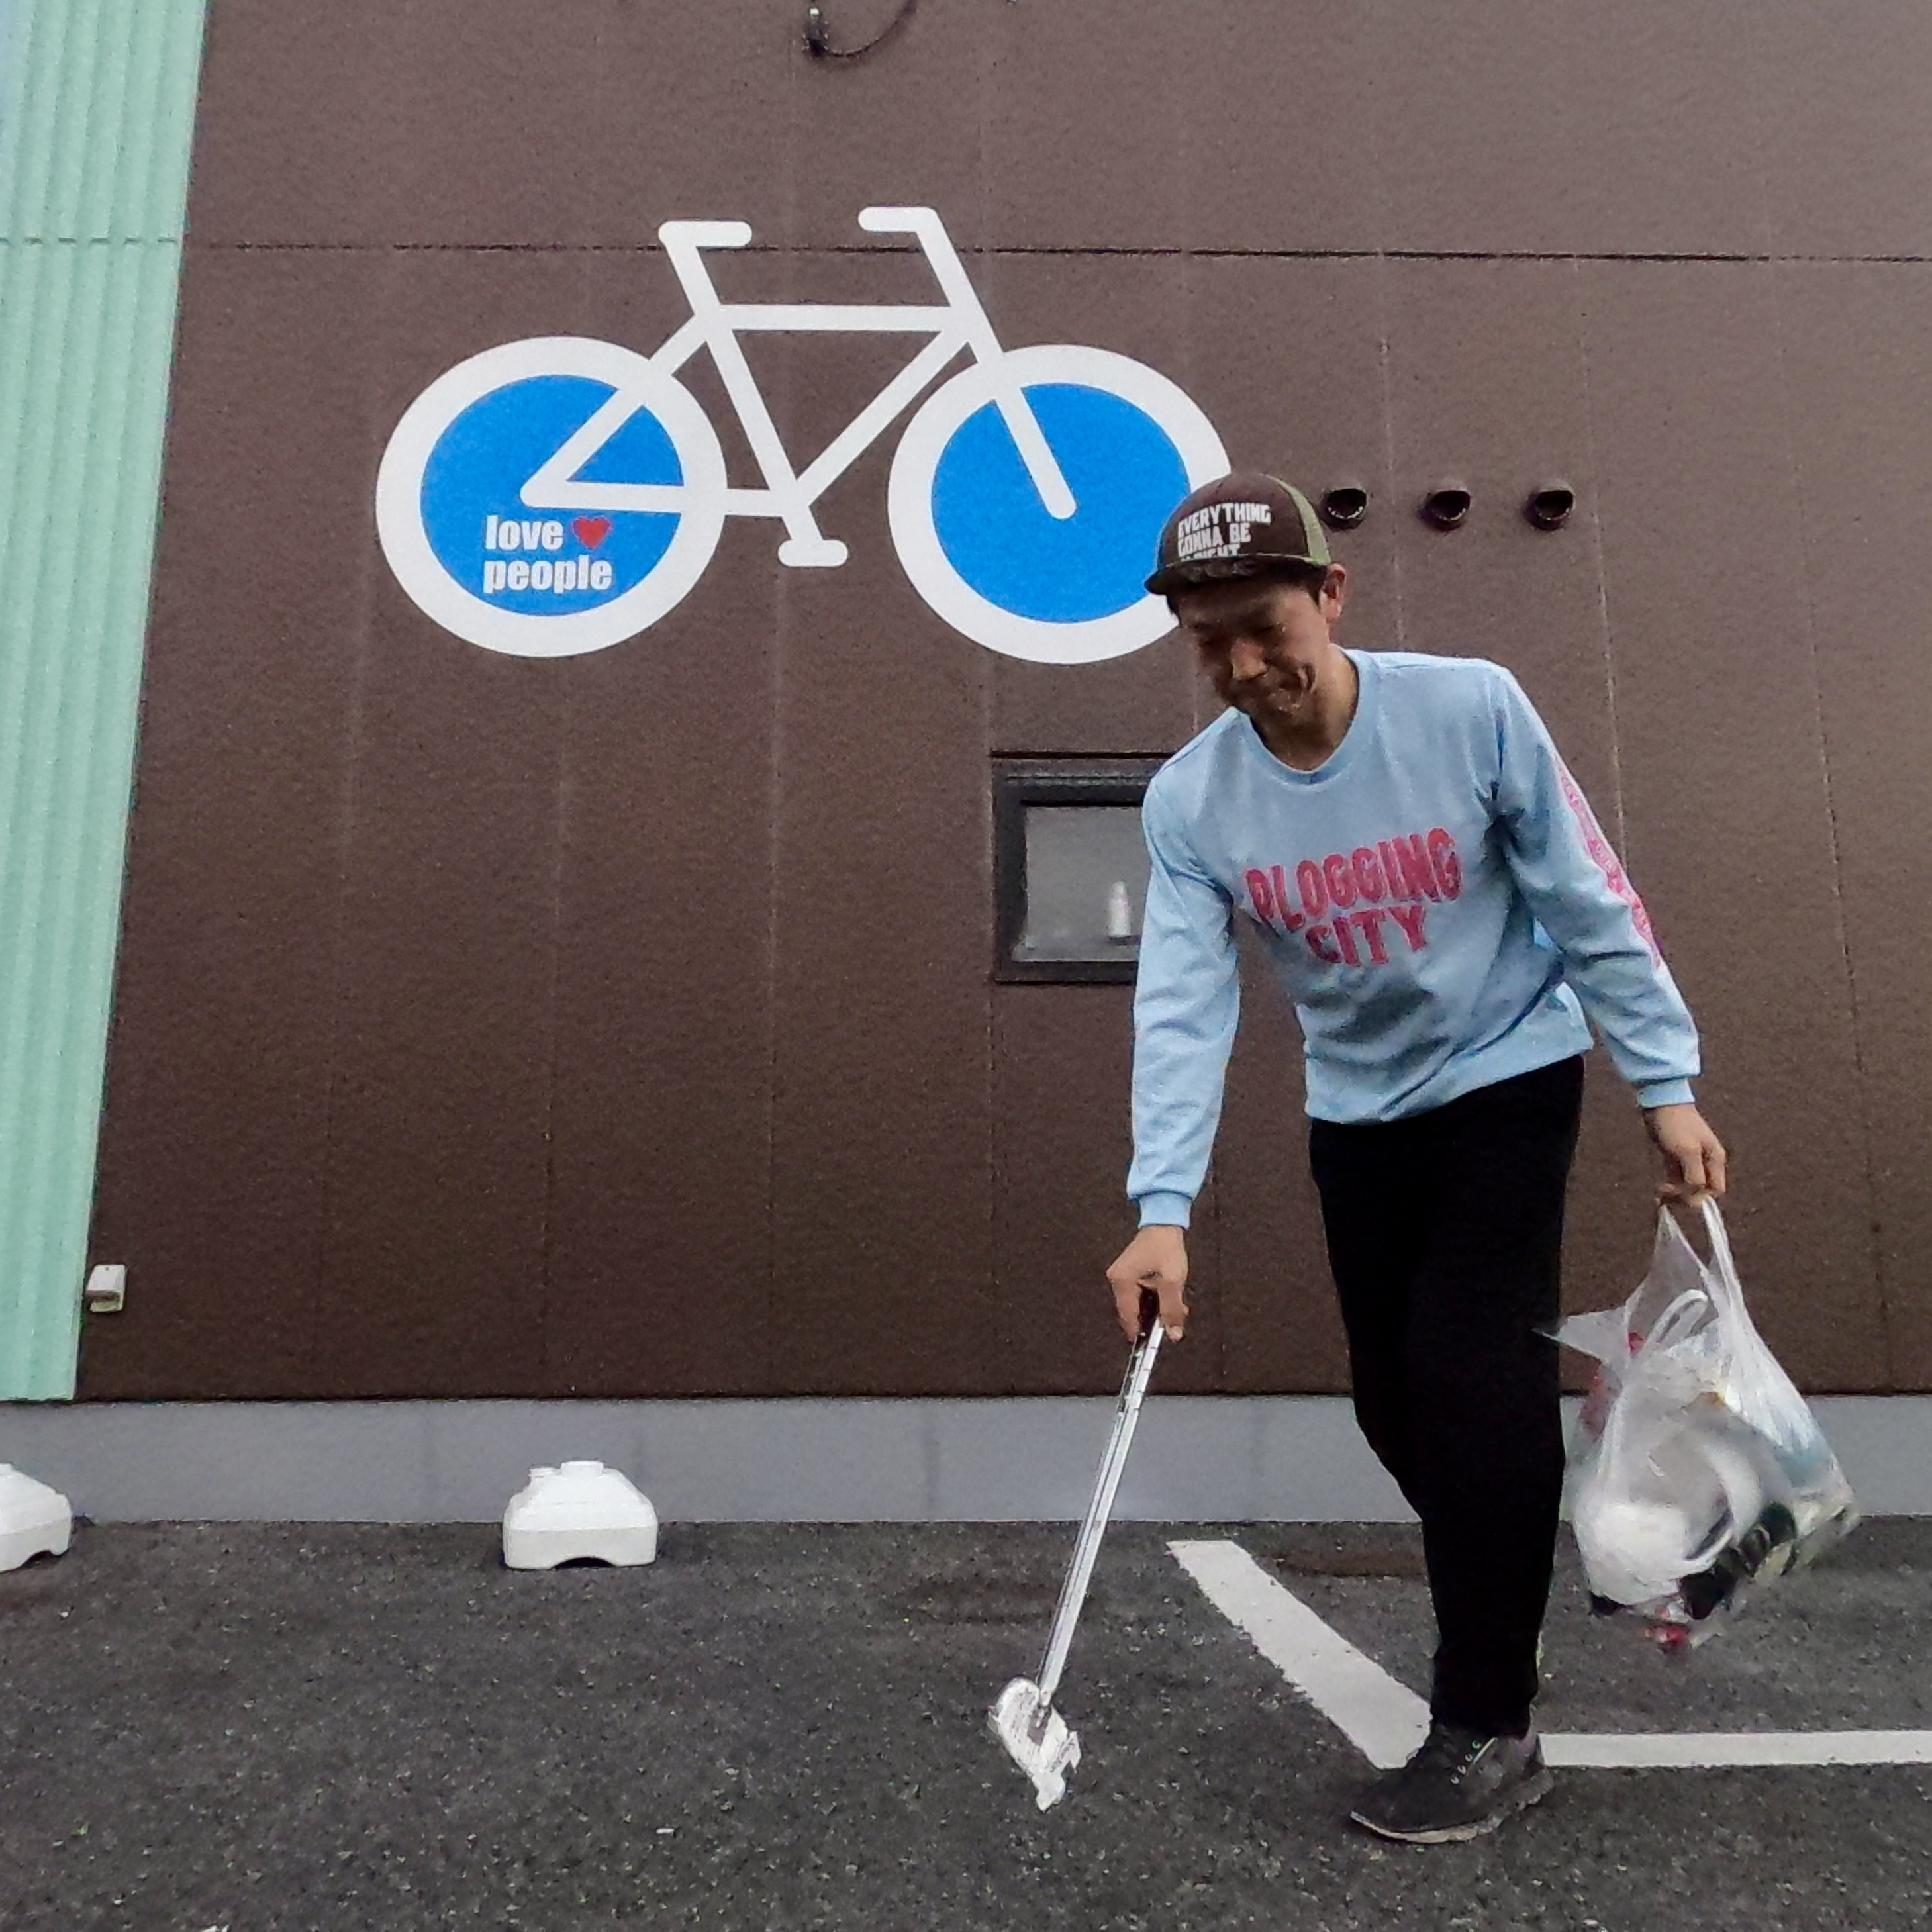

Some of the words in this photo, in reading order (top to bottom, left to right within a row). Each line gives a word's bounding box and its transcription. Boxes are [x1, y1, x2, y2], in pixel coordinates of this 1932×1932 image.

[485, 514, 564, 550] love
[1177, 501, 1272, 540] EVERYTHING
[1177, 525, 1224, 557] GONNA
[1229, 522, 1252, 544] BE
[483, 554, 612, 594] people
[1304, 903, 1427, 967] CITY
